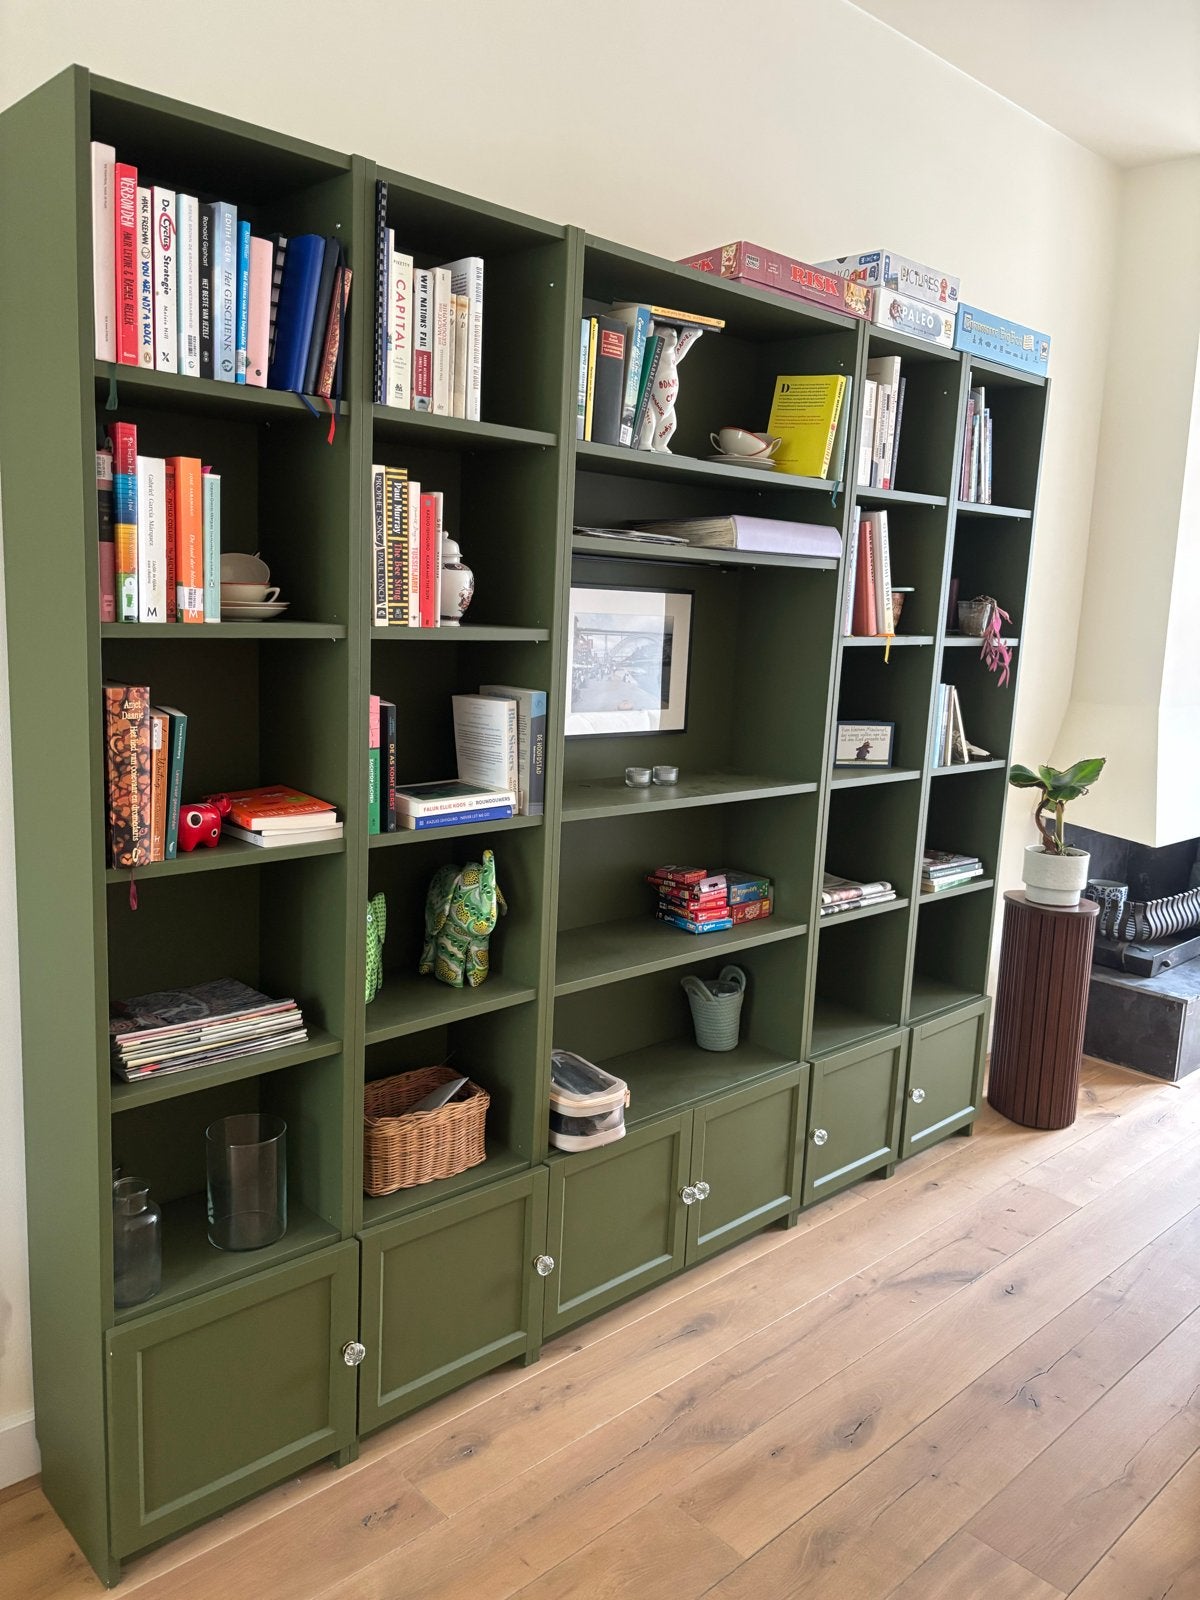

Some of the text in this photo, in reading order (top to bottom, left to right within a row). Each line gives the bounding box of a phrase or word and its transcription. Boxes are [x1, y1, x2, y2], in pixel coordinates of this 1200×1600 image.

[121, 177, 136, 228] VERBONDEN
[160, 199, 171, 295] De Cyclus Strategie
[142, 261, 150, 277] YOU
[900, 264, 939, 292] PICTURES
[142, 279, 150, 293] ARE
[790, 264, 839, 296] RISK
[143, 296, 151, 313] NOT
[223, 289, 232, 352] GESCHENK
[395, 280, 406, 350] CAPITAL
[903, 305, 934, 328] PALEO
[143, 324, 151, 346] ROCK
[419, 332, 427, 347] FAIL
[393, 482, 402, 534] Paul Murray
[393, 543, 402, 558] The
[394, 579, 402, 600] Sting
[130, 726, 138, 740] Het
[537, 734, 542, 742] DE
[389, 744, 395, 753] DE
[389, 756, 395, 765] AS
[132, 795, 137, 804] en
